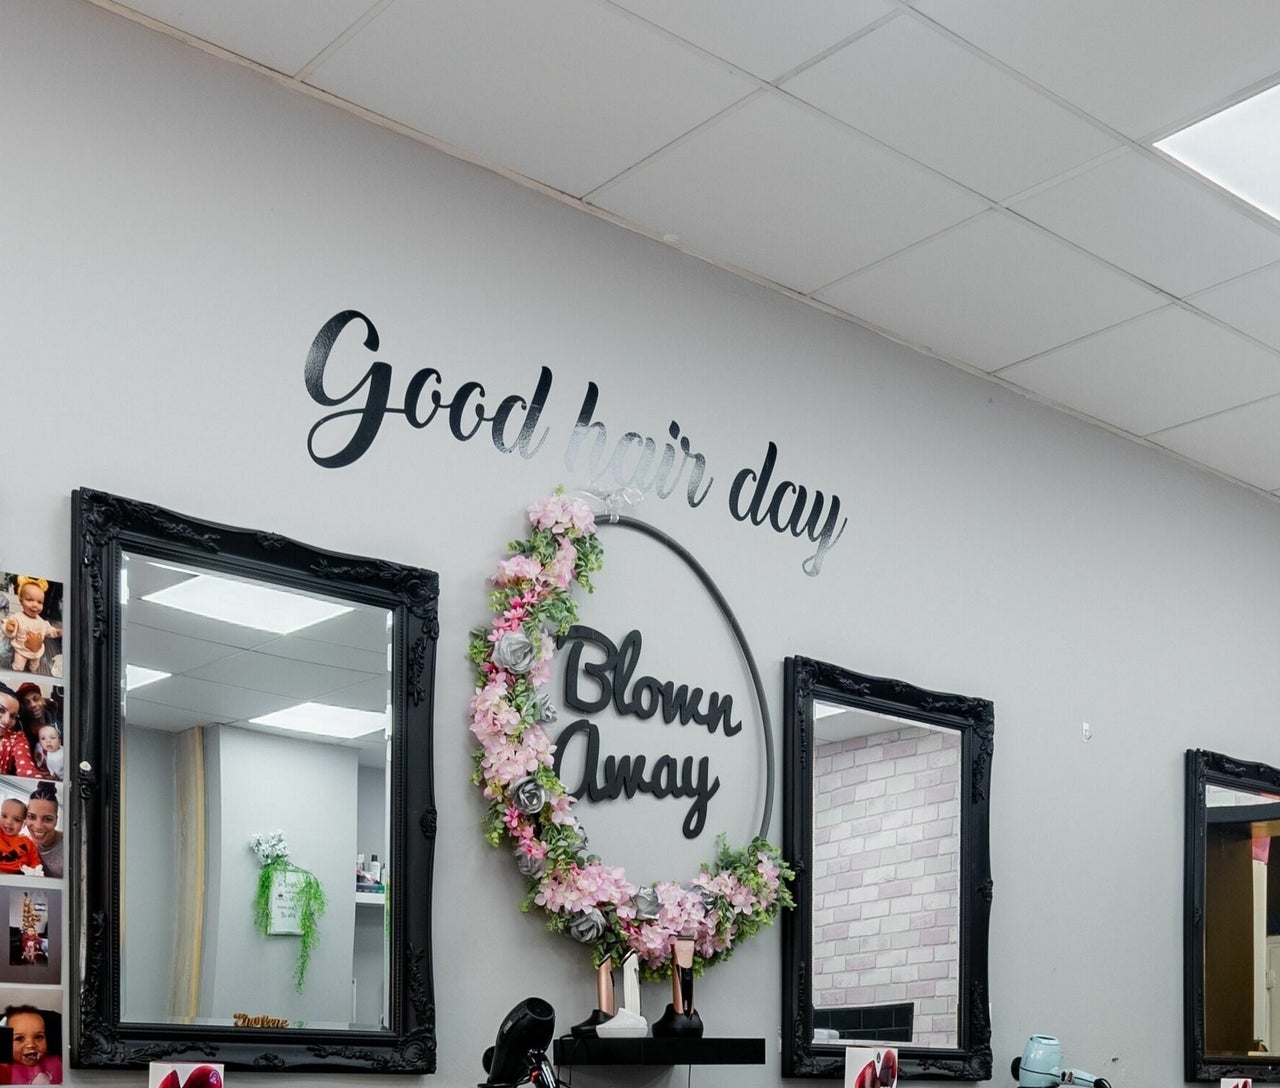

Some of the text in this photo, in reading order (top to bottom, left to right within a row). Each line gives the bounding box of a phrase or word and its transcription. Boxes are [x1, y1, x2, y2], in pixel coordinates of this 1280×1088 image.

[304, 309, 848, 578] Good hair day
[557, 624, 743, 737] Blown
[553, 719, 721, 840] Away
